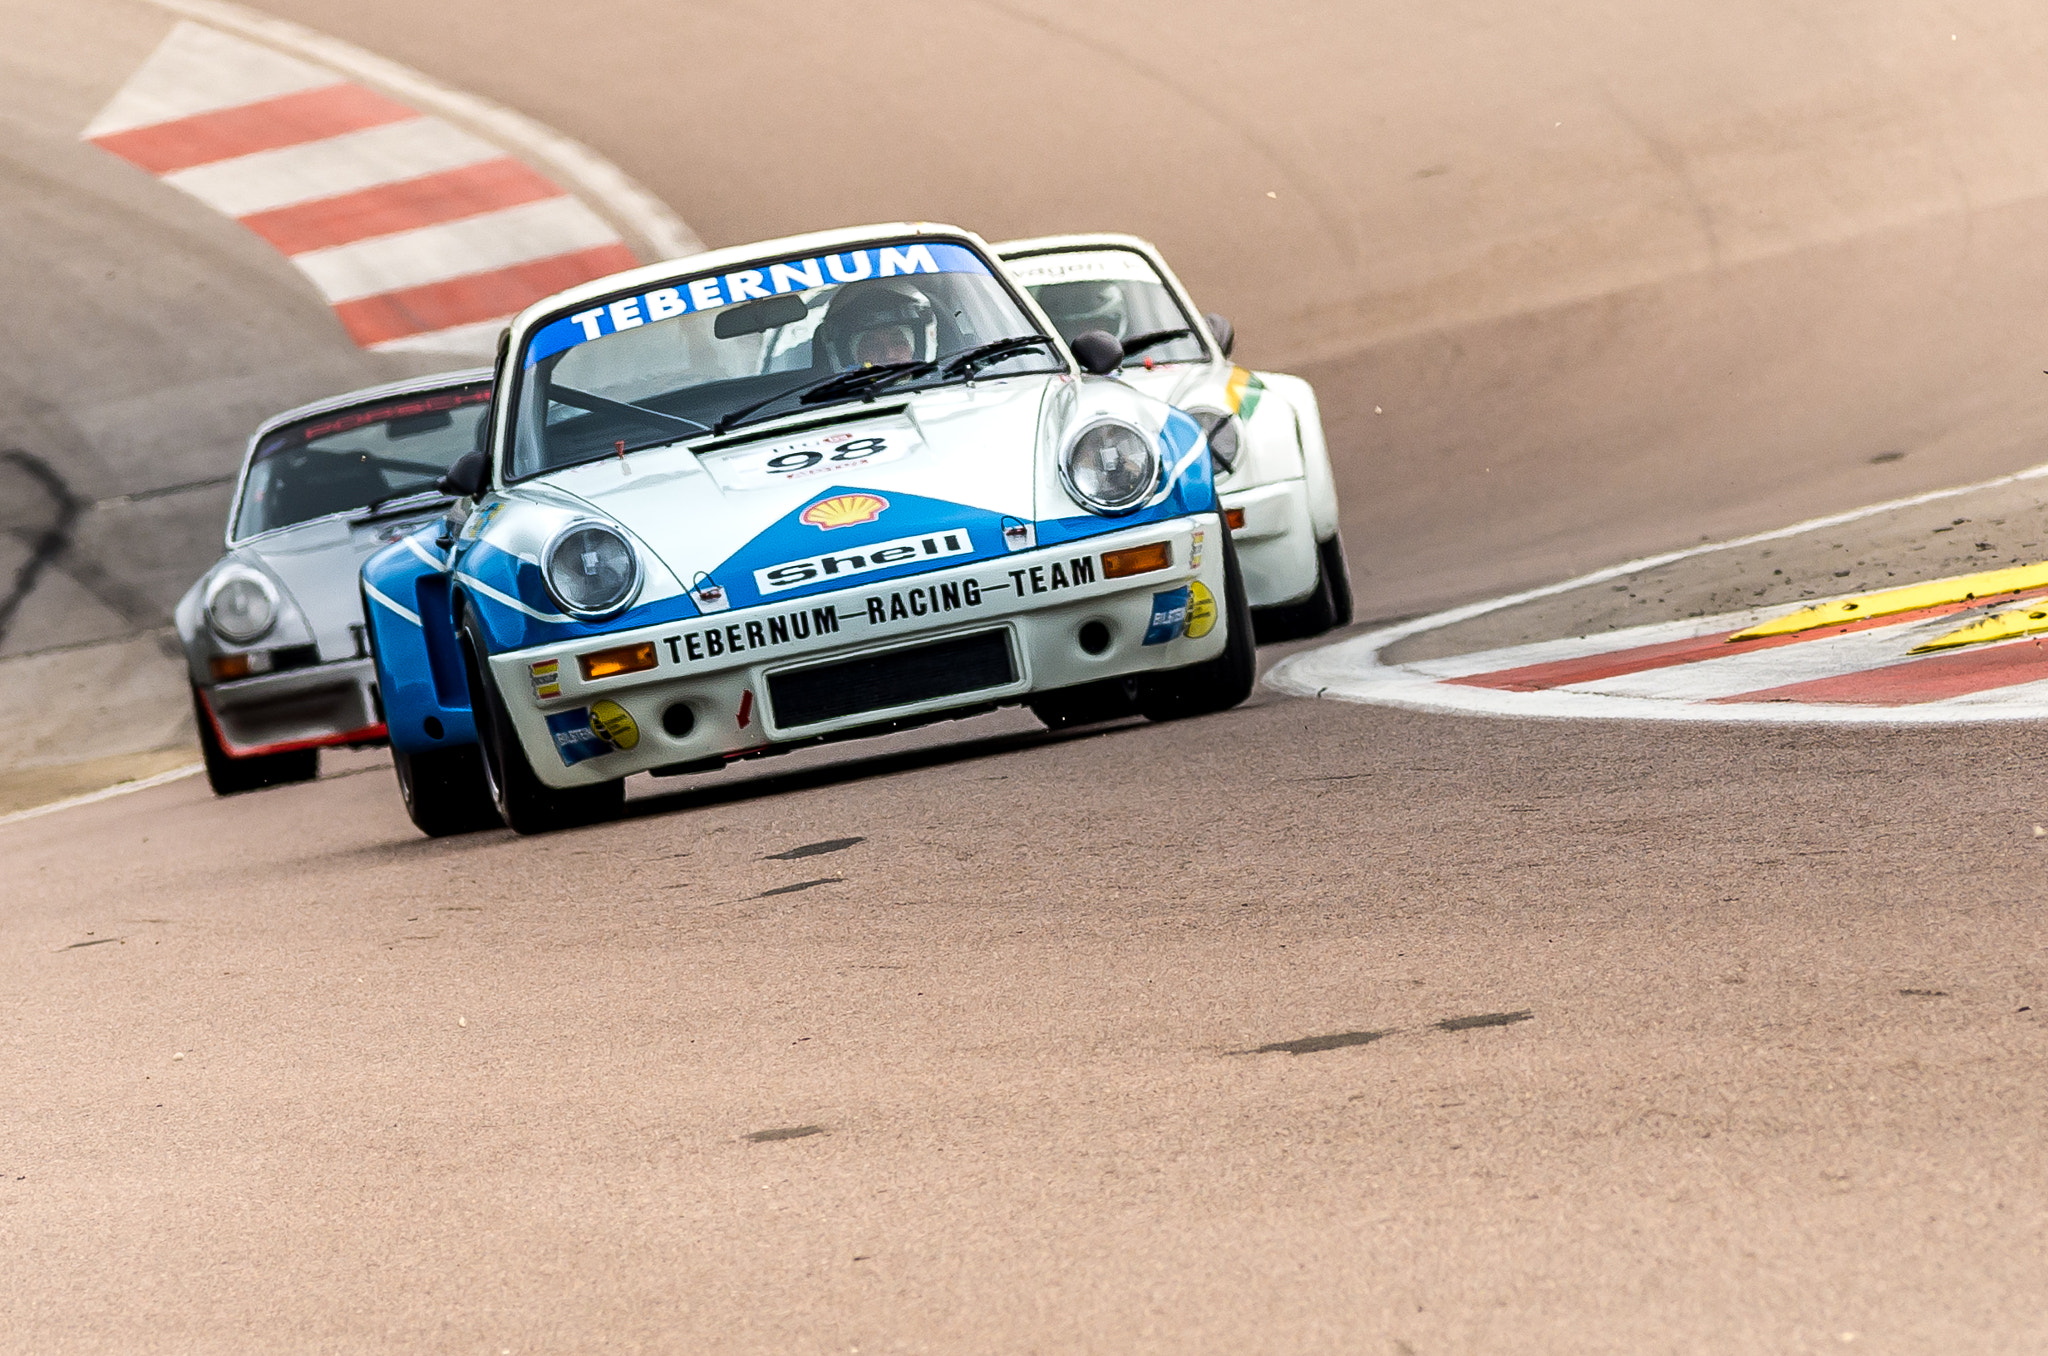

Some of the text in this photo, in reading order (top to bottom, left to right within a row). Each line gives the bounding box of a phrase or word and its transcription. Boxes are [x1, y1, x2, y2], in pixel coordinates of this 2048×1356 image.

[571, 244, 940, 341] TEBERNUM
[305, 390, 491, 440] PORSCH
[766, 437, 888, 474] 98
[767, 535, 961, 586] Shell
